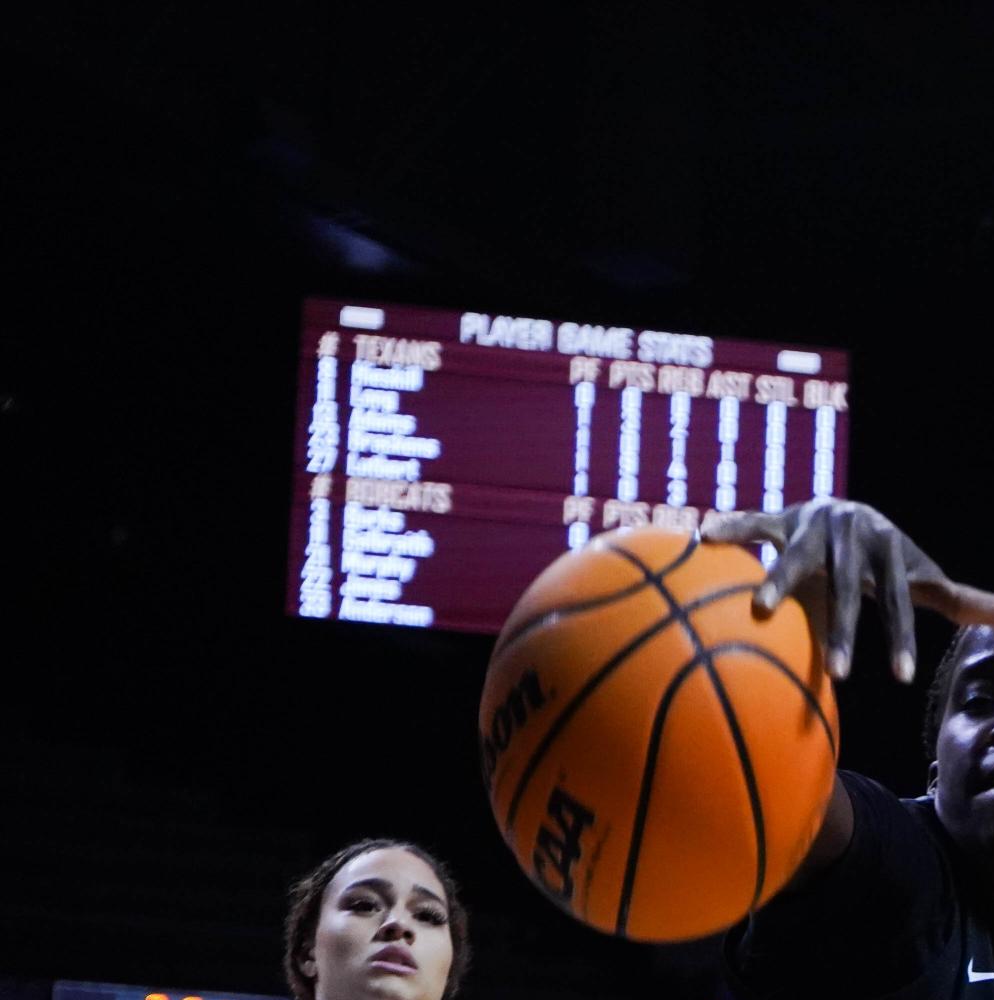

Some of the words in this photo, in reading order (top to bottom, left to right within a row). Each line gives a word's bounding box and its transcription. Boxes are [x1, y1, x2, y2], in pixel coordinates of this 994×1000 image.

[460, 312, 553, 351] PLAYER
[557, 322, 634, 359] GAME
[637, 330, 713, 368] STATS
